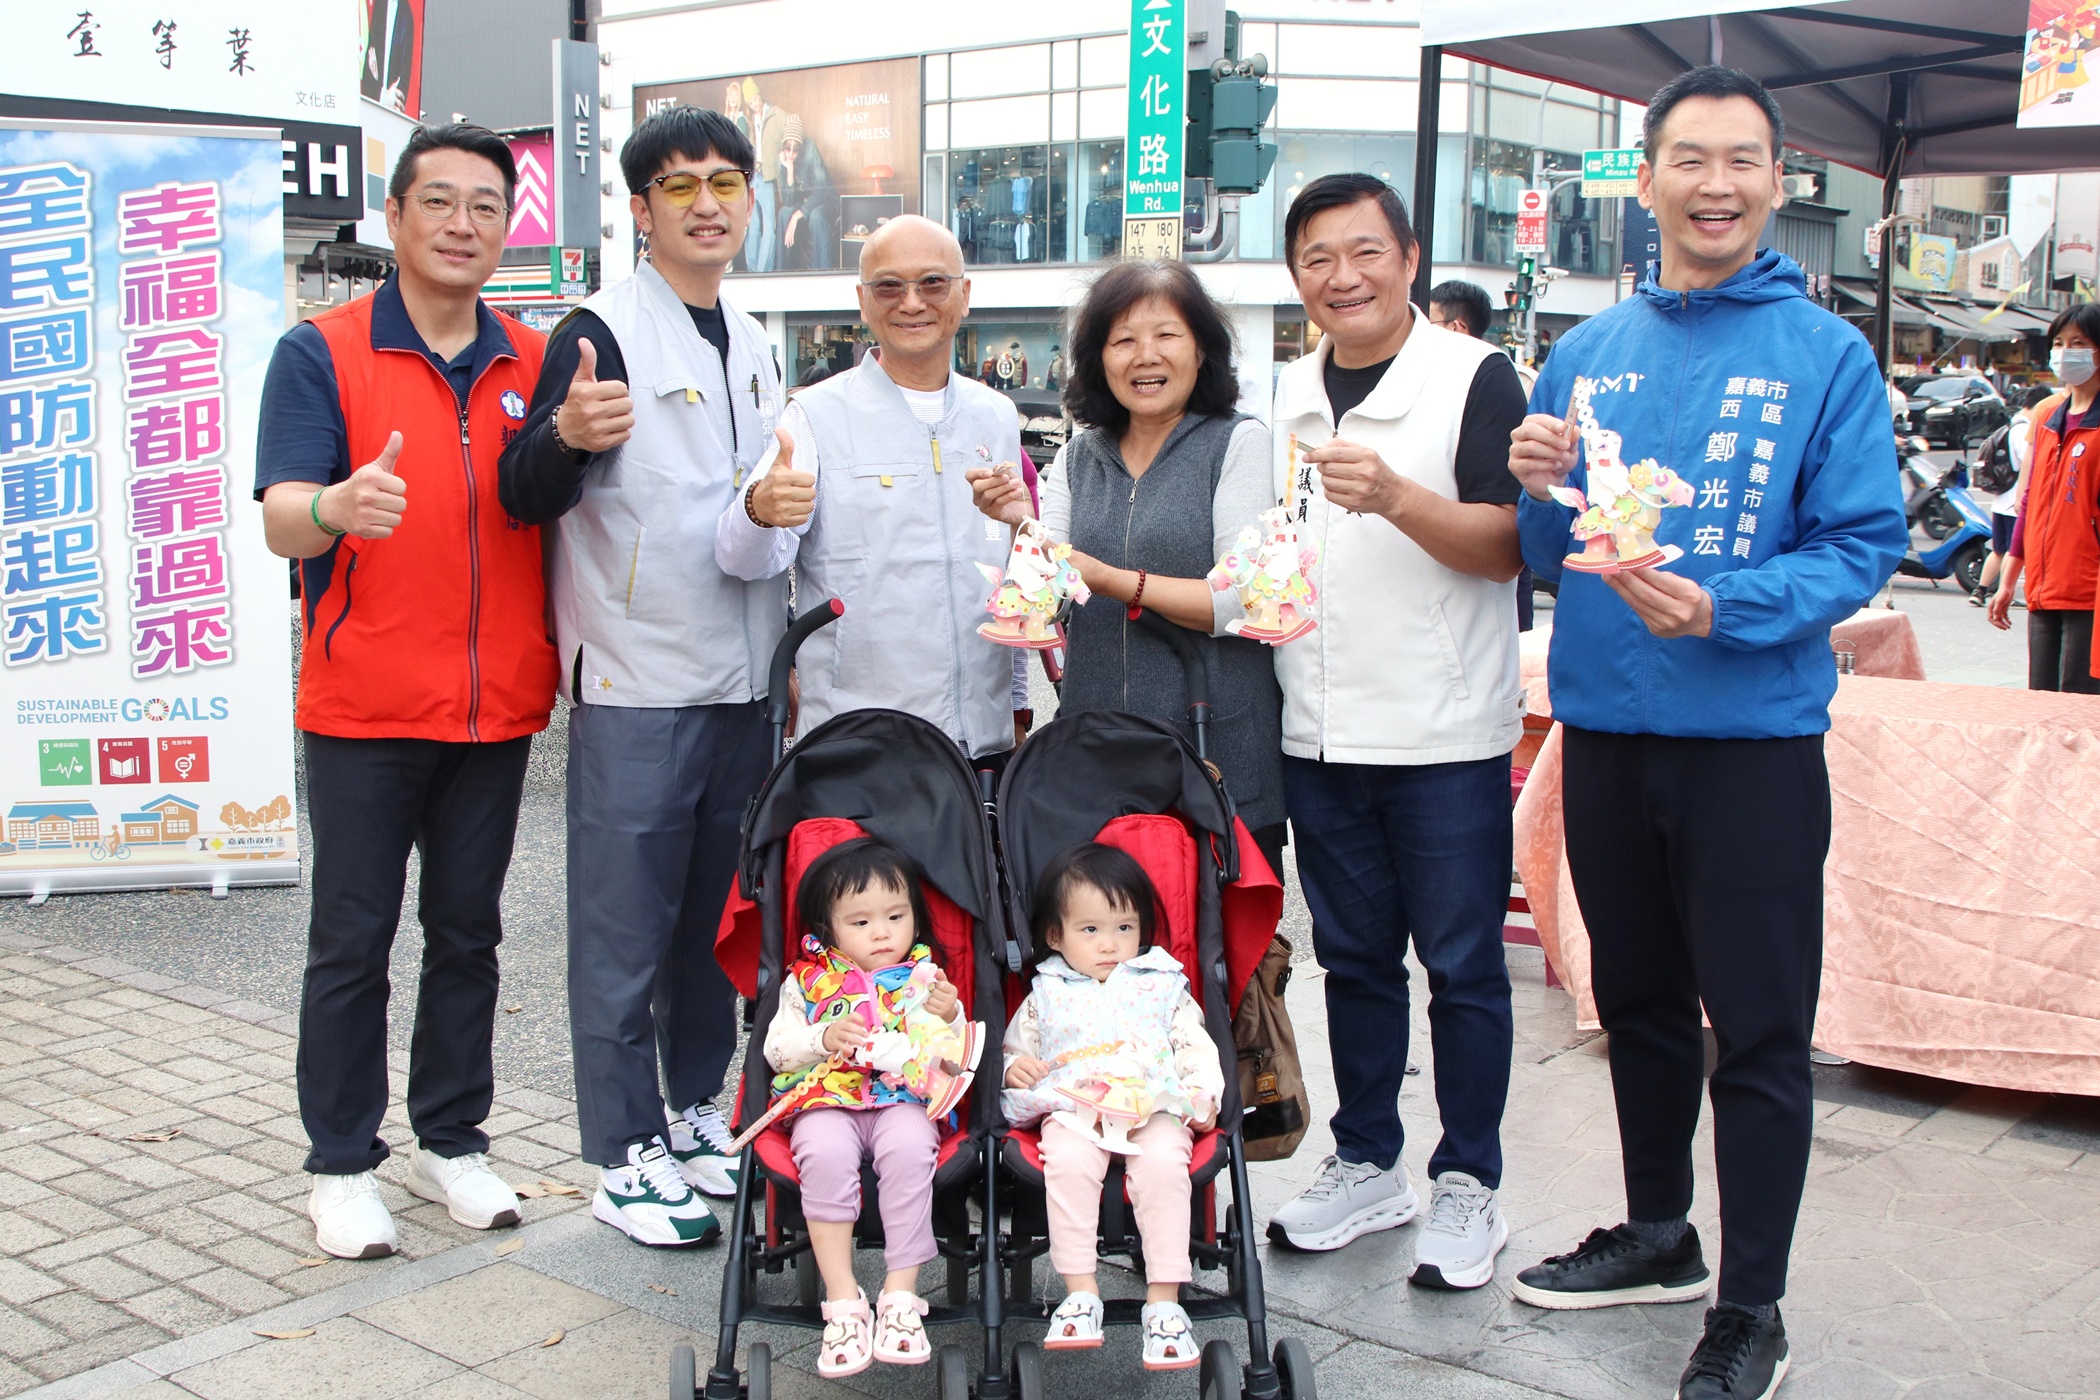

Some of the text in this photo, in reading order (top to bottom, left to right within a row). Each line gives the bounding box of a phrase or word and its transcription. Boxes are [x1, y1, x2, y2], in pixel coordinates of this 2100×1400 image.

[295, 90, 337, 109] 文化店
[845, 93, 890, 107] NATURAL
[1138, 14, 1172, 176] 文化路
[845, 112, 869, 125] EASY
[575, 93, 590, 175] NET
[845, 127, 891, 141] TIMELESS
[1129, 179, 1179, 194] Wenhua
[1144, 197, 1165, 211] Rd.
[1130, 222, 1173, 237] 147 180
[1724, 376, 1789, 400] 嘉義市
[0, 166, 101, 662] 全民國防動起來
[1719, 399, 1784, 425] 西 區
[123, 187, 228, 674] 幸福全都靠過來
[1297, 467, 1314, 523] 議員
[1692, 431, 1739, 556] 鄭光宏
[1732, 438, 1776, 559] 嘉義市議員
[17, 699, 118, 711] SUSTAINABLE
[121, 696, 229, 722] GOALS
[17, 712, 118, 724] DEVELOPMENT
[43, 743, 50, 754] 3
[102, 741, 109, 752] 4
[161, 740, 168, 751] 5
